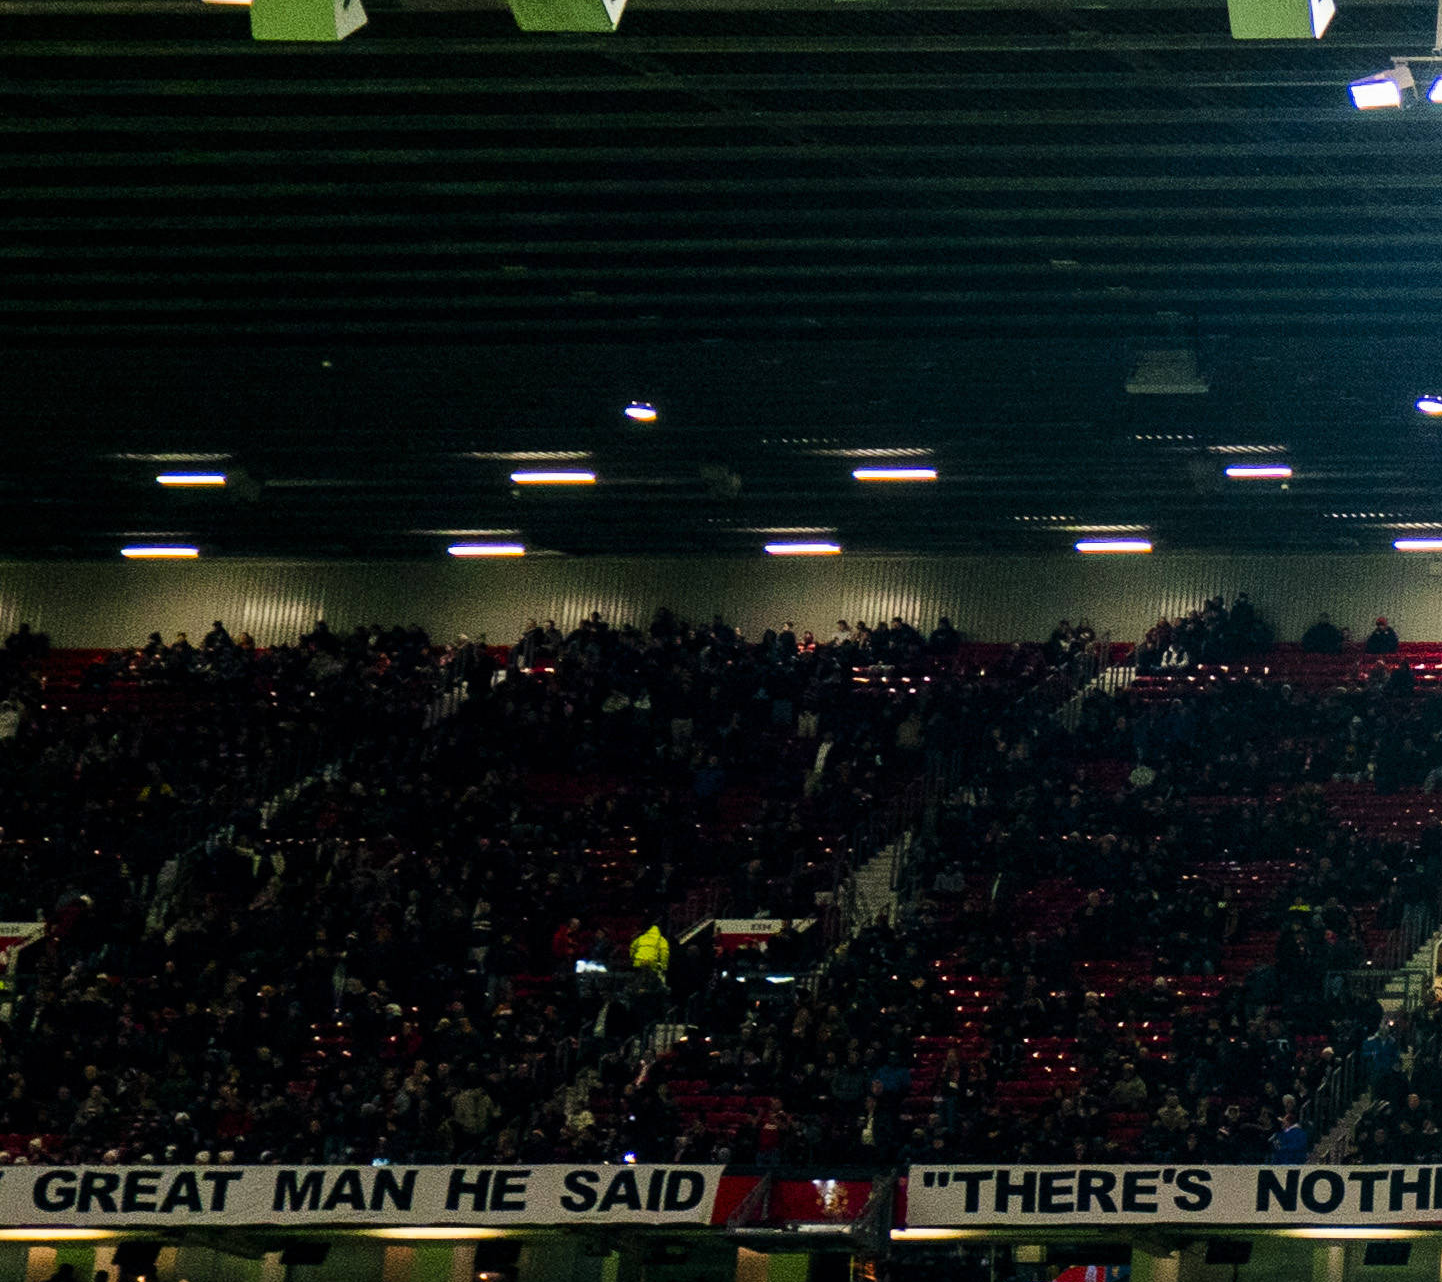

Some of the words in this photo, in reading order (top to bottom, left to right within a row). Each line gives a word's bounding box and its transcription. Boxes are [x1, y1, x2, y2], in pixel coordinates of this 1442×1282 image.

[33, 1169, 242, 1215] GREAT
[273, 1169, 417, 1214] MAN
[445, 1169, 531, 1212] HE
[561, 1168, 706, 1213] SAID
[922, 1168, 1214, 1214] "THERE'S
